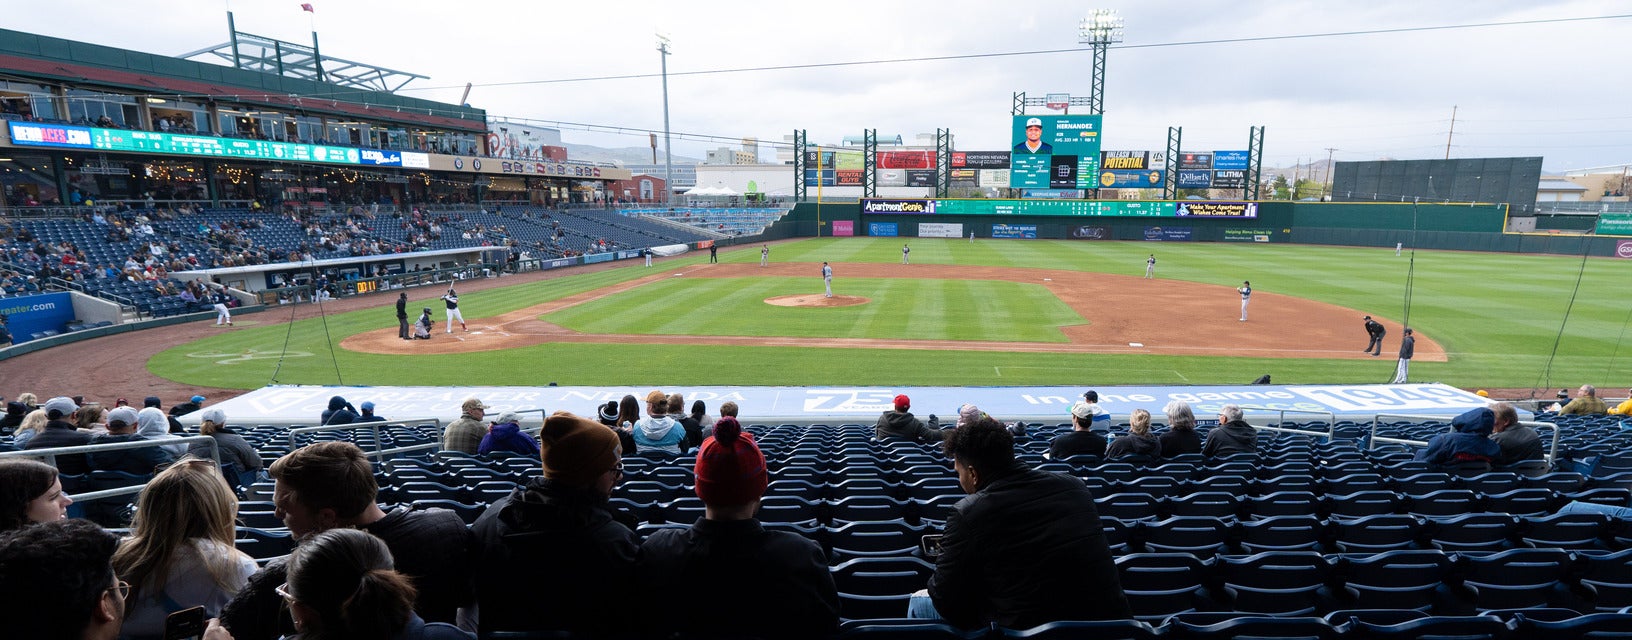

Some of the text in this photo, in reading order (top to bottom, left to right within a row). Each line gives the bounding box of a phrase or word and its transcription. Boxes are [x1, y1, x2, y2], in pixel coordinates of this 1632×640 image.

[1104, 157, 1144, 168] POTENTIAL
[1180, 173, 1209, 182] Dillard's
[1021, 394, 1070, 404] In
[1167, 391, 1293, 404] game
[1313, 386, 1486, 407] 1949
